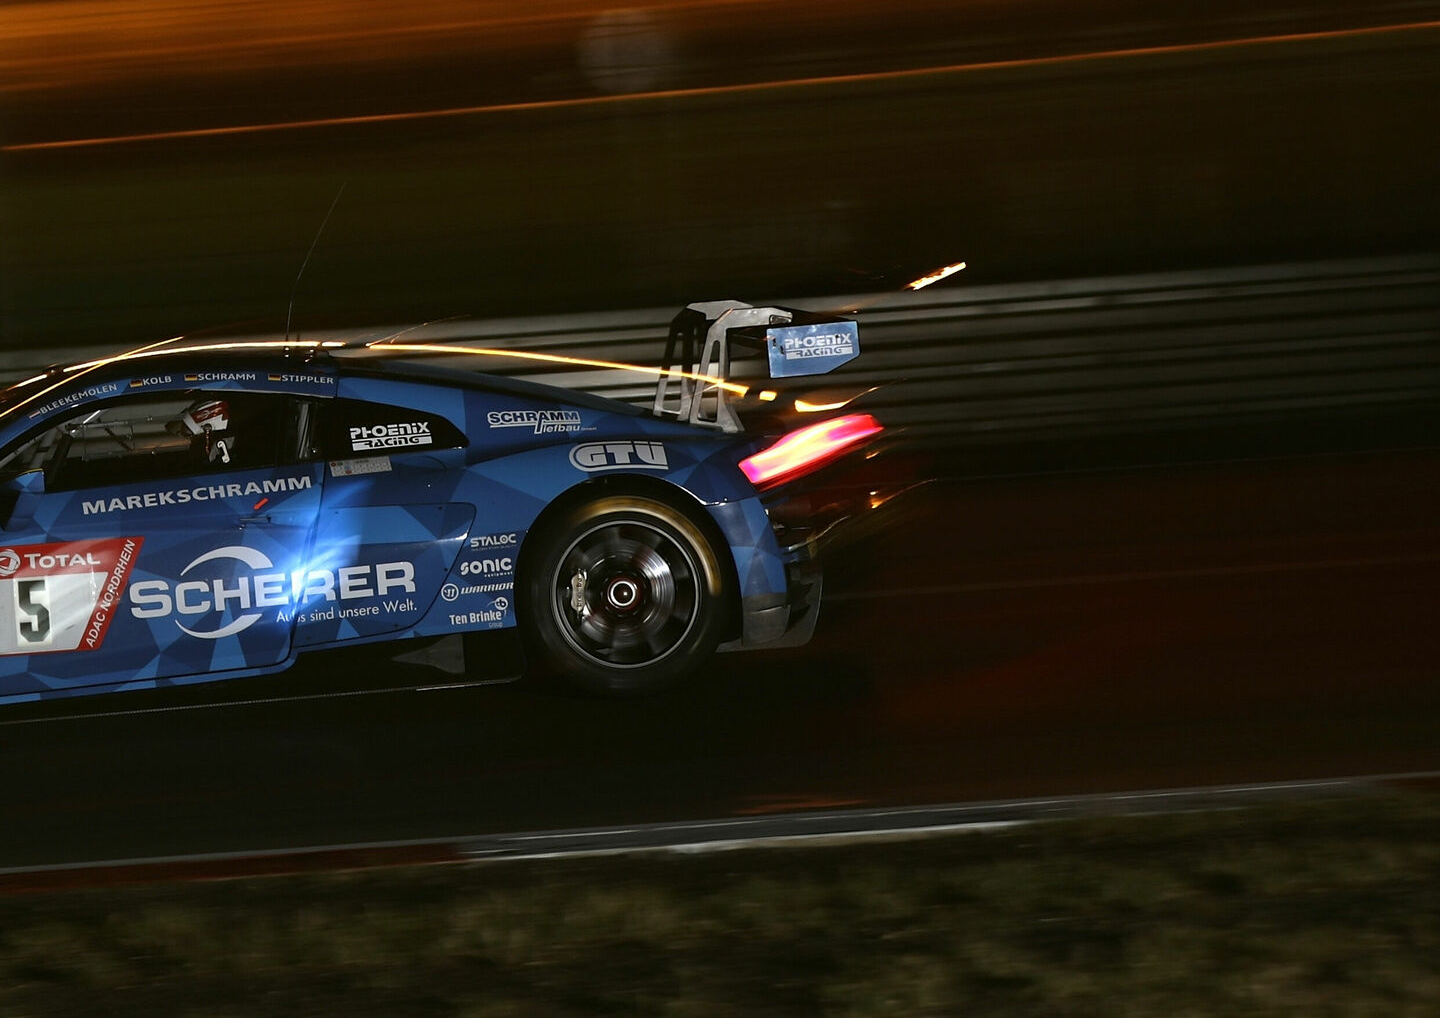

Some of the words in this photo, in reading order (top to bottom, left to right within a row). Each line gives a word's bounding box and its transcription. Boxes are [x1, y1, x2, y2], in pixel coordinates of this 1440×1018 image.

[40, 384, 118, 414] BLEEKEMOLEN
[143, 375, 172, 386] KOLB
[198, 373, 256, 382] SCHRAMM
[281, 374, 334, 384] STIPPLER
[488, 411, 581, 425] SCHRAMM
[82, 476, 312, 515] MAREKSCHRAMM
[470, 534, 517, 548] STALOC
[85, 612, 106, 648] ADAC
[102, 538, 137, 612] NORDRHEIN
[129, 561, 416, 619] SCHERER
[461, 582, 514, 594] WARRIOR
[17, 579, 50, 643] 5
[310, 606, 335, 622] sind
[338, 605, 380, 619] unsere
[383, 598, 417, 613] Welt.
[449, 614, 468, 625] Ten
[469, 610, 502, 624] Brinke
